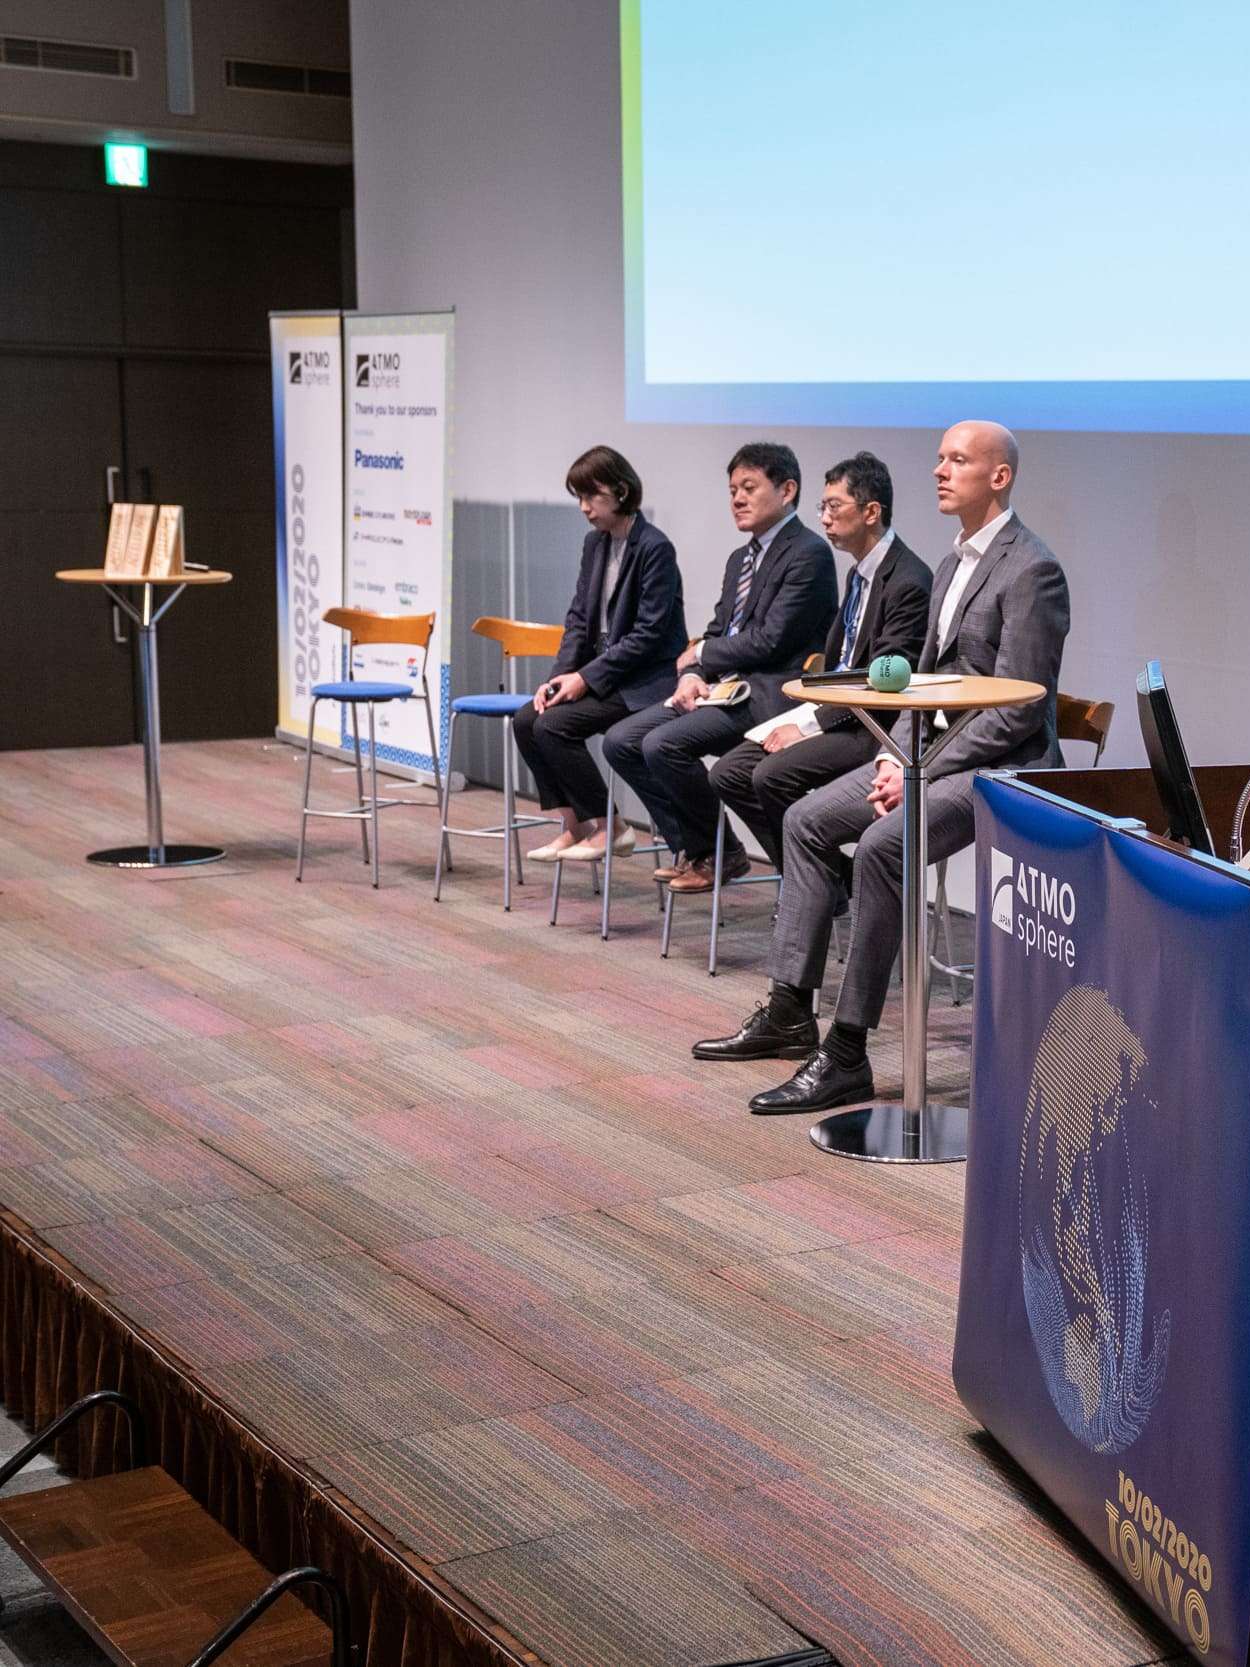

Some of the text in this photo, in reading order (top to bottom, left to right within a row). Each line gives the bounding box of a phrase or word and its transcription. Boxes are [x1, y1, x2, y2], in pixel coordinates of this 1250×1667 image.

[372, 353, 401, 370] ATMO
[354, 449, 404, 470] Panasonic
[291, 464, 306, 696] 10/02/2020
[308, 553, 320, 698] OKYO
[1017, 862, 1076, 925] ATMO
[1017, 910, 1076, 968] sphere
[1105, 1499, 1211, 1655] TOKYO
[1118, 1469, 1212, 1592] 10/02/2020
